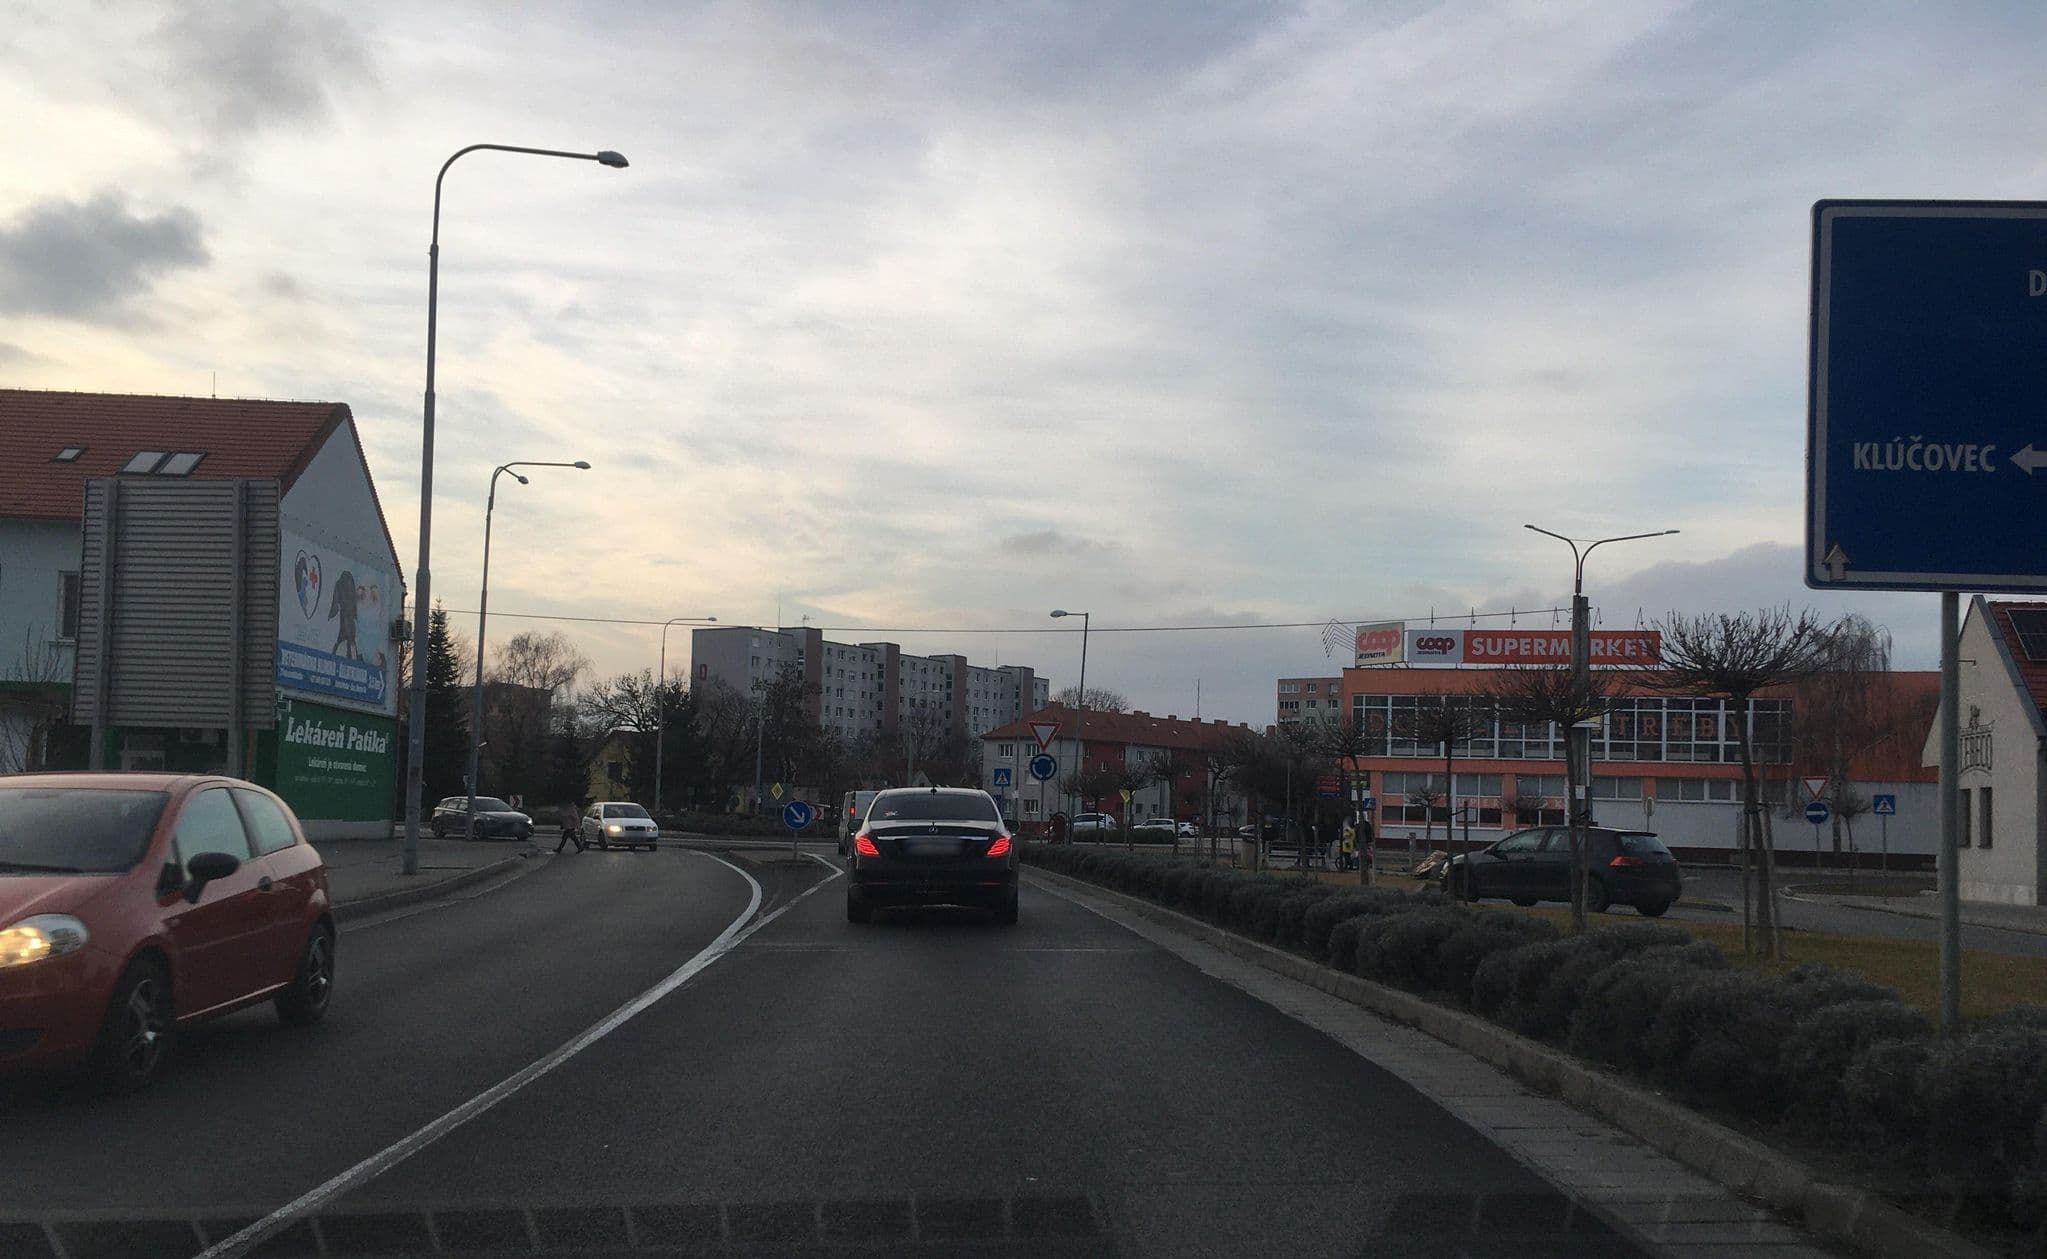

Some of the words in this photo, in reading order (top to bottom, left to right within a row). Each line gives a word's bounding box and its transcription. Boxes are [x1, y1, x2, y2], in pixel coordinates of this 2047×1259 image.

[1854, 435, 1996, 472] KLÚČOVEC
[1471, 637, 1652, 657] SUPERMRKET
[286, 717, 346, 749] Lekáreň
[347, 726, 386, 753] Patika
